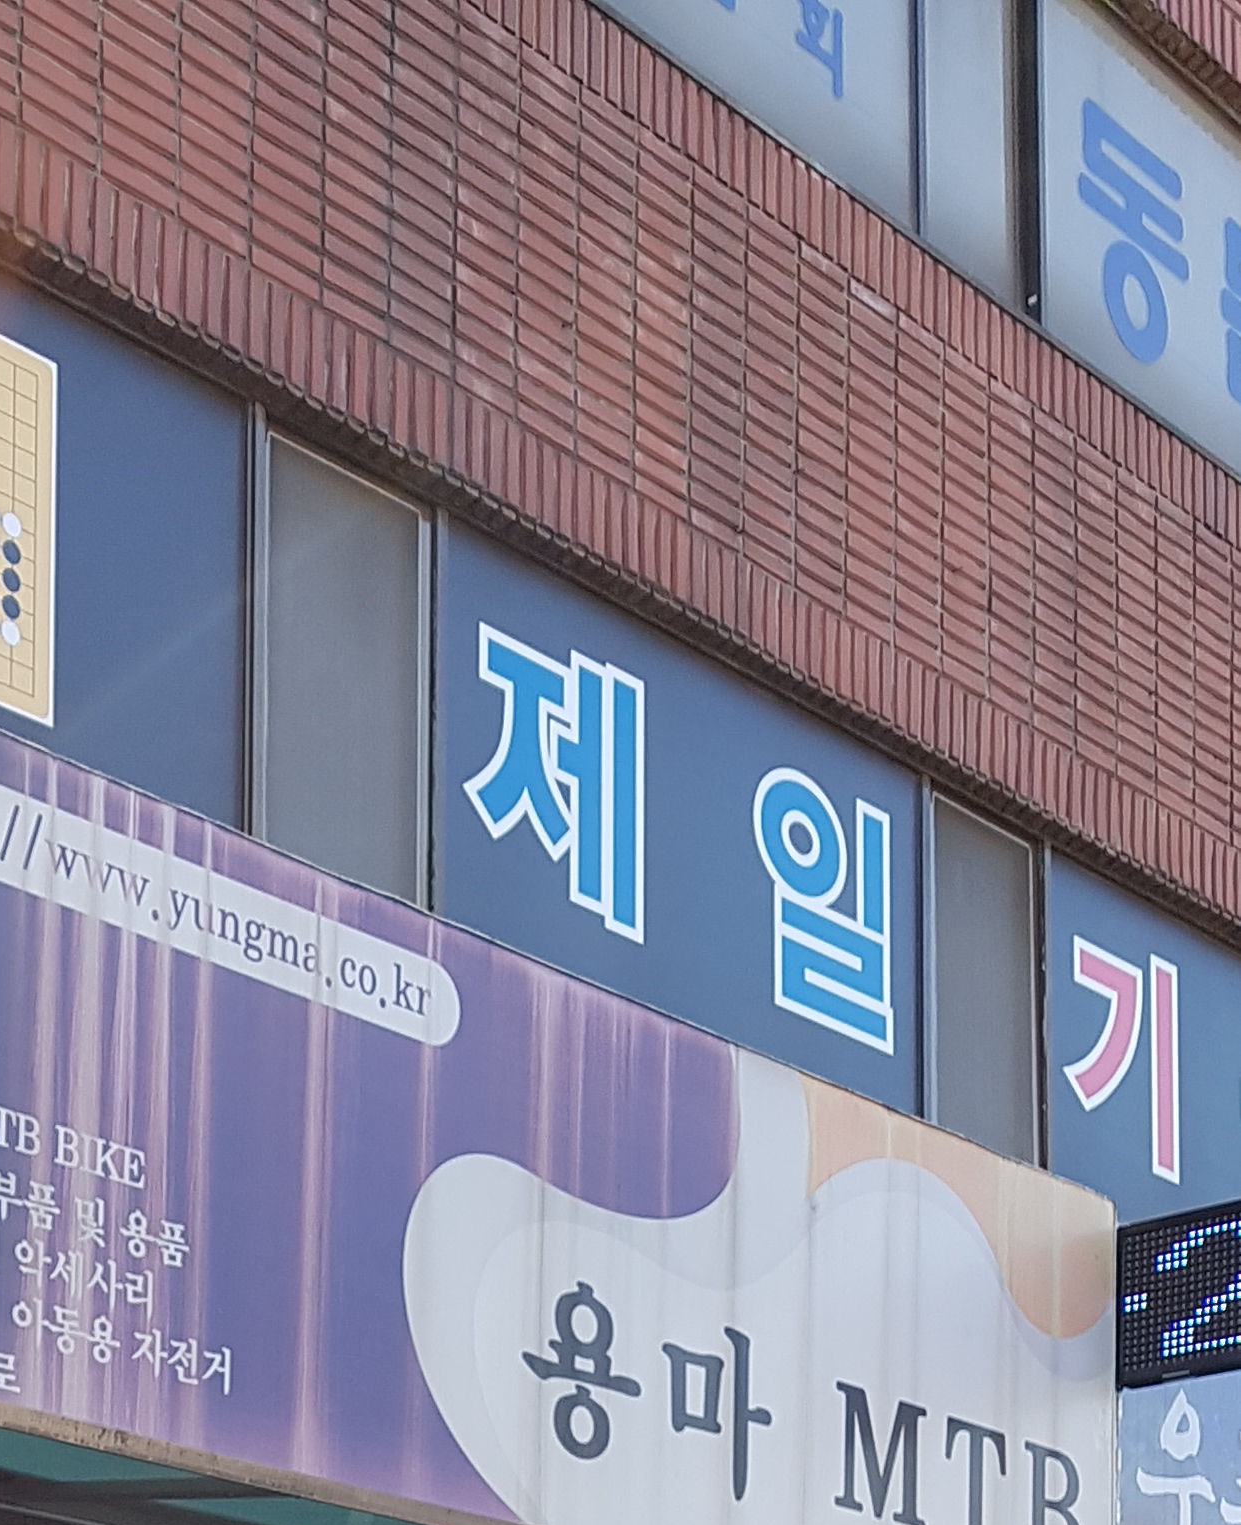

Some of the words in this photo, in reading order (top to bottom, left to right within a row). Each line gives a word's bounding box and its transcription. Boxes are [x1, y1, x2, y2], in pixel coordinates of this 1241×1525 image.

[54, 1124, 145, 1189] BIKE
[75, 1195, 104, 1247] 및
[120, 1209, 190, 1269] 용품
[14, 1240, 154, 1320] 악세사리
[12, 1298, 120, 1363] 아동용
[132, 1330, 232, 1396] 자전거
[522, 1280, 772, 1502] 용마
